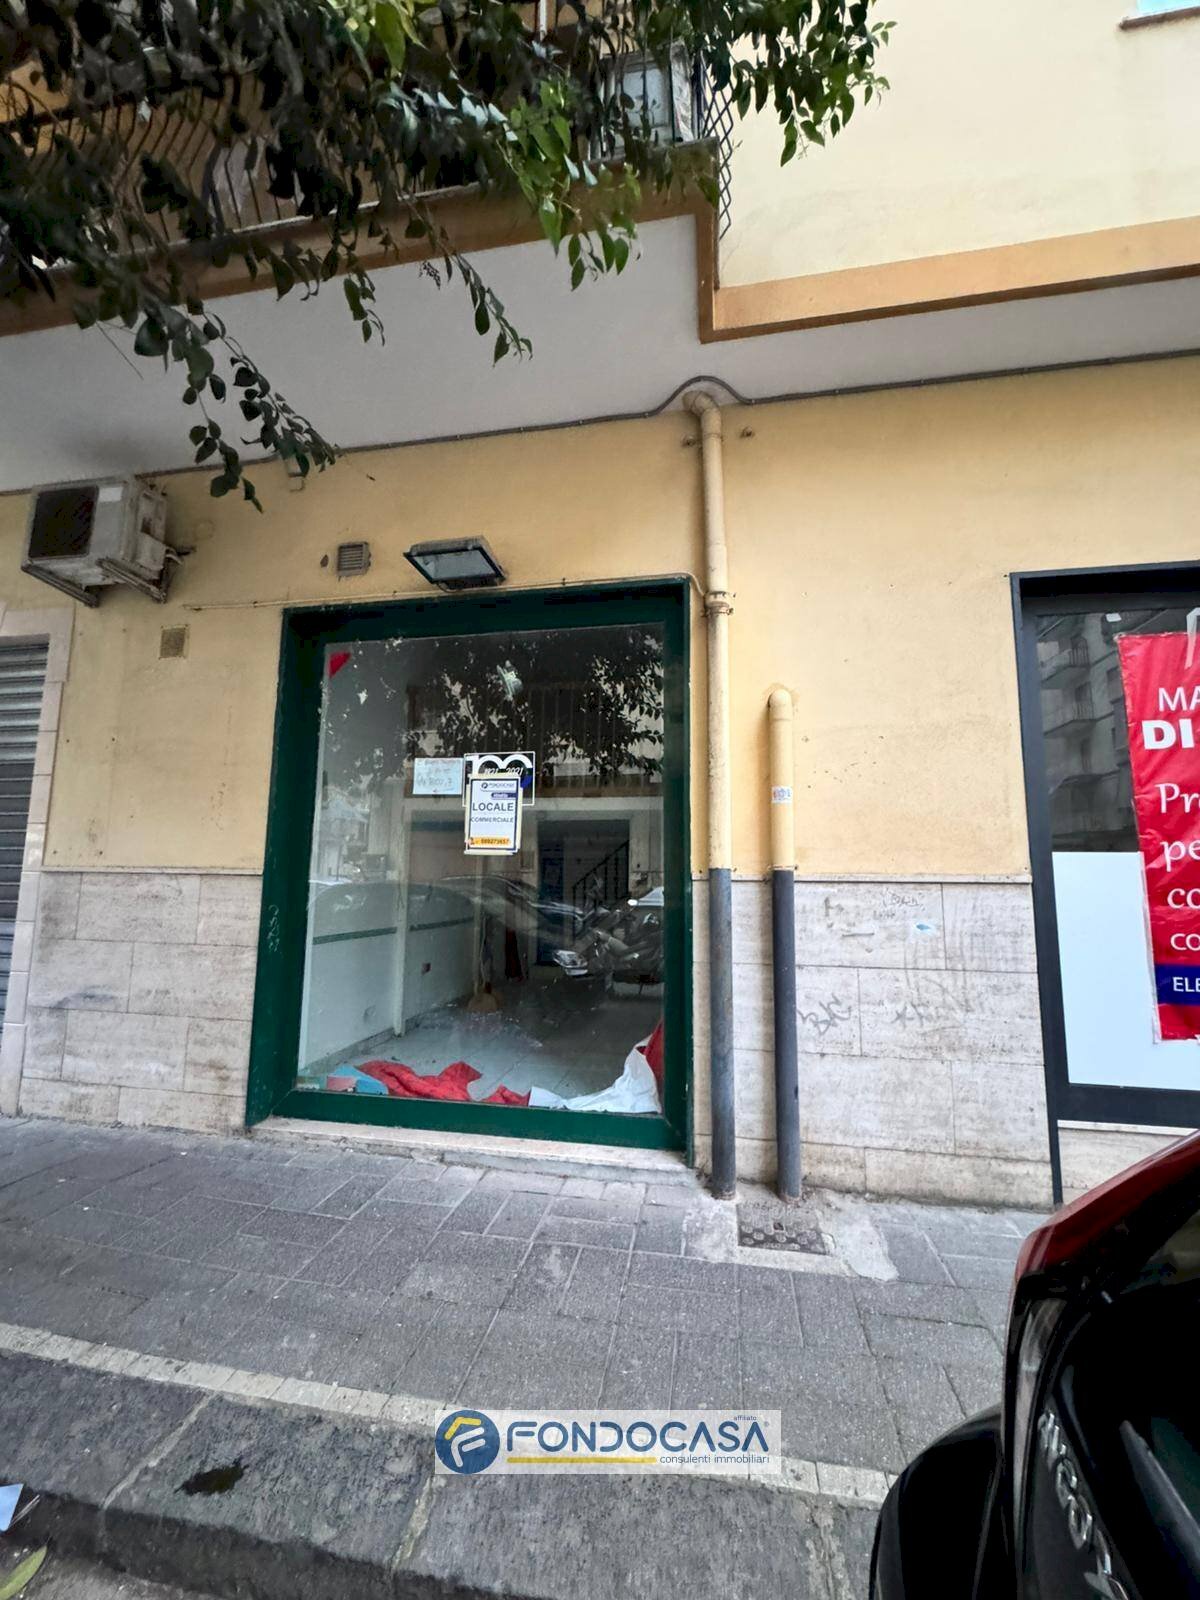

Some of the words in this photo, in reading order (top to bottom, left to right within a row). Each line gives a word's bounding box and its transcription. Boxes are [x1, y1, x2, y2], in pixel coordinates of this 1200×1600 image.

[1142, 718, 1195, 750] DI
[472, 802, 514, 812] LOCALE
[1154, 783, 1200, 814] Pr
[471, 816, 514, 824] COMMERCIALE
